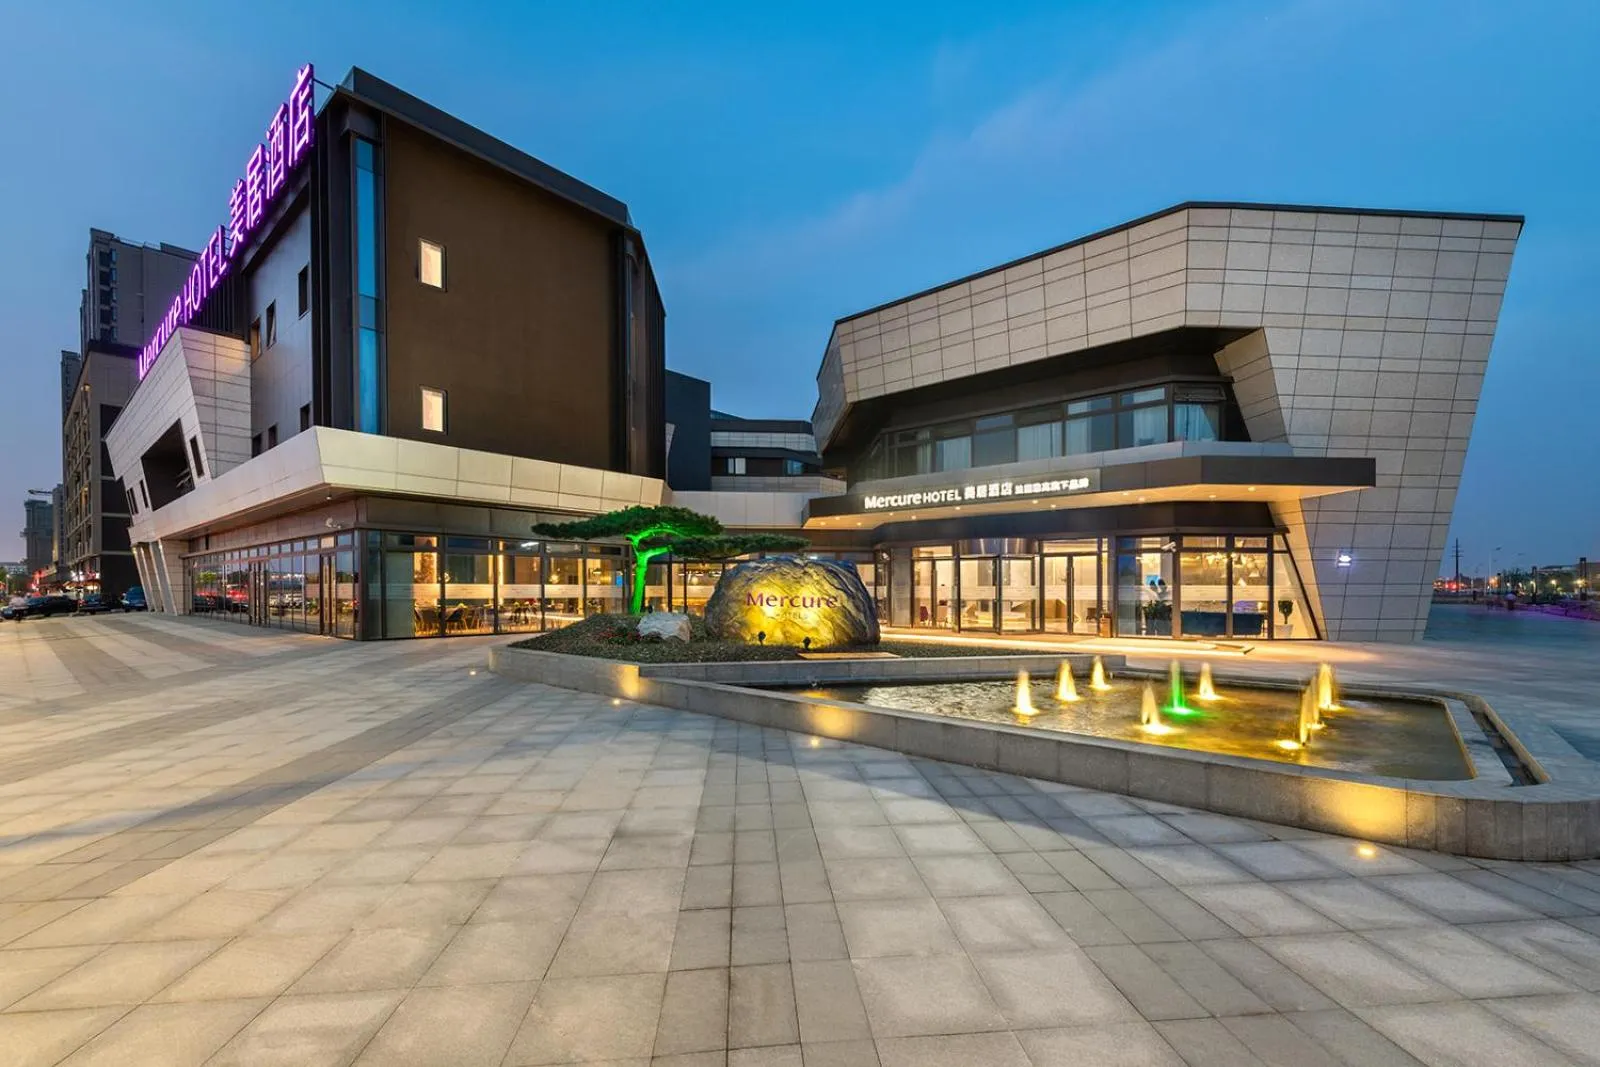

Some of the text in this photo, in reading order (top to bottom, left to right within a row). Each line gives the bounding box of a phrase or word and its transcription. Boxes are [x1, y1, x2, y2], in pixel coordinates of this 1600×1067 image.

[138, 63, 314, 381] Mercure HOTEL 美居酒店
[864, 492, 922, 509] Mercure
[923, 488, 962, 504] HOTEL
[746, 591, 838, 609] Mercure
